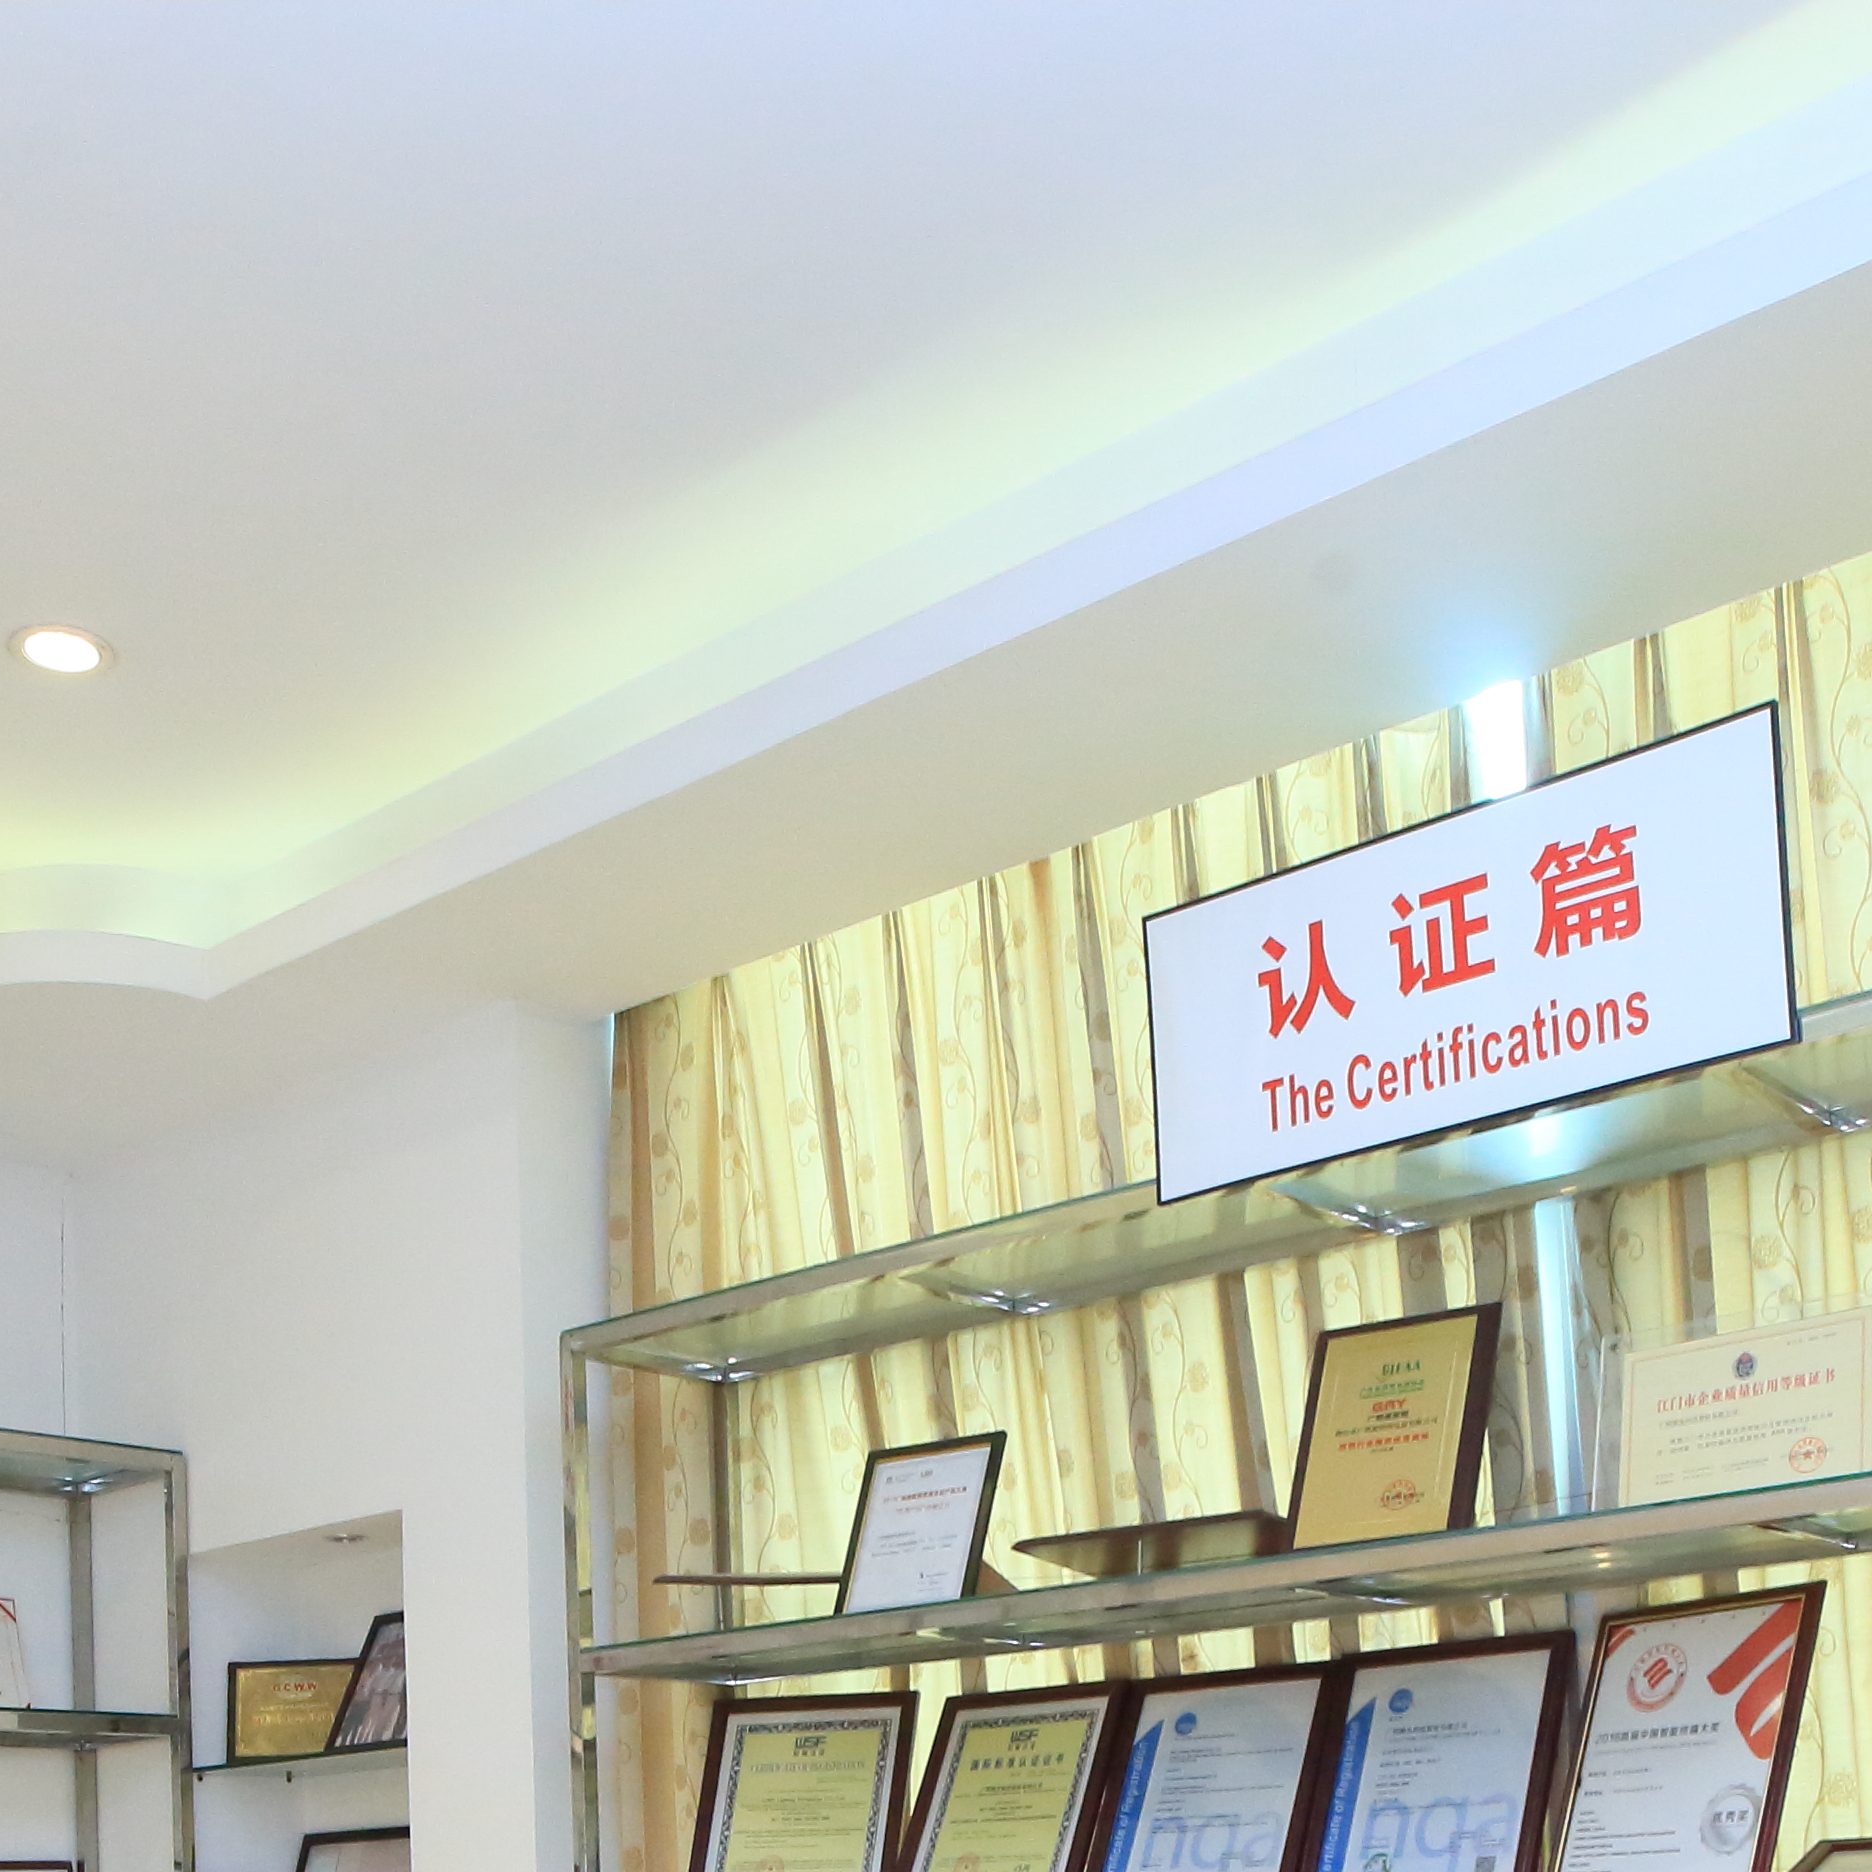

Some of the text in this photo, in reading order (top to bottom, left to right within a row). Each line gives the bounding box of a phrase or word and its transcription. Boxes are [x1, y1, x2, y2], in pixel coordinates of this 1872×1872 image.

[1257, 823, 1643, 1040] 认证篇
[1262, 989, 1650, 1132] The Certifications
[1656, 1368, 1836, 1414] 江门市企业质量信用等级证书
